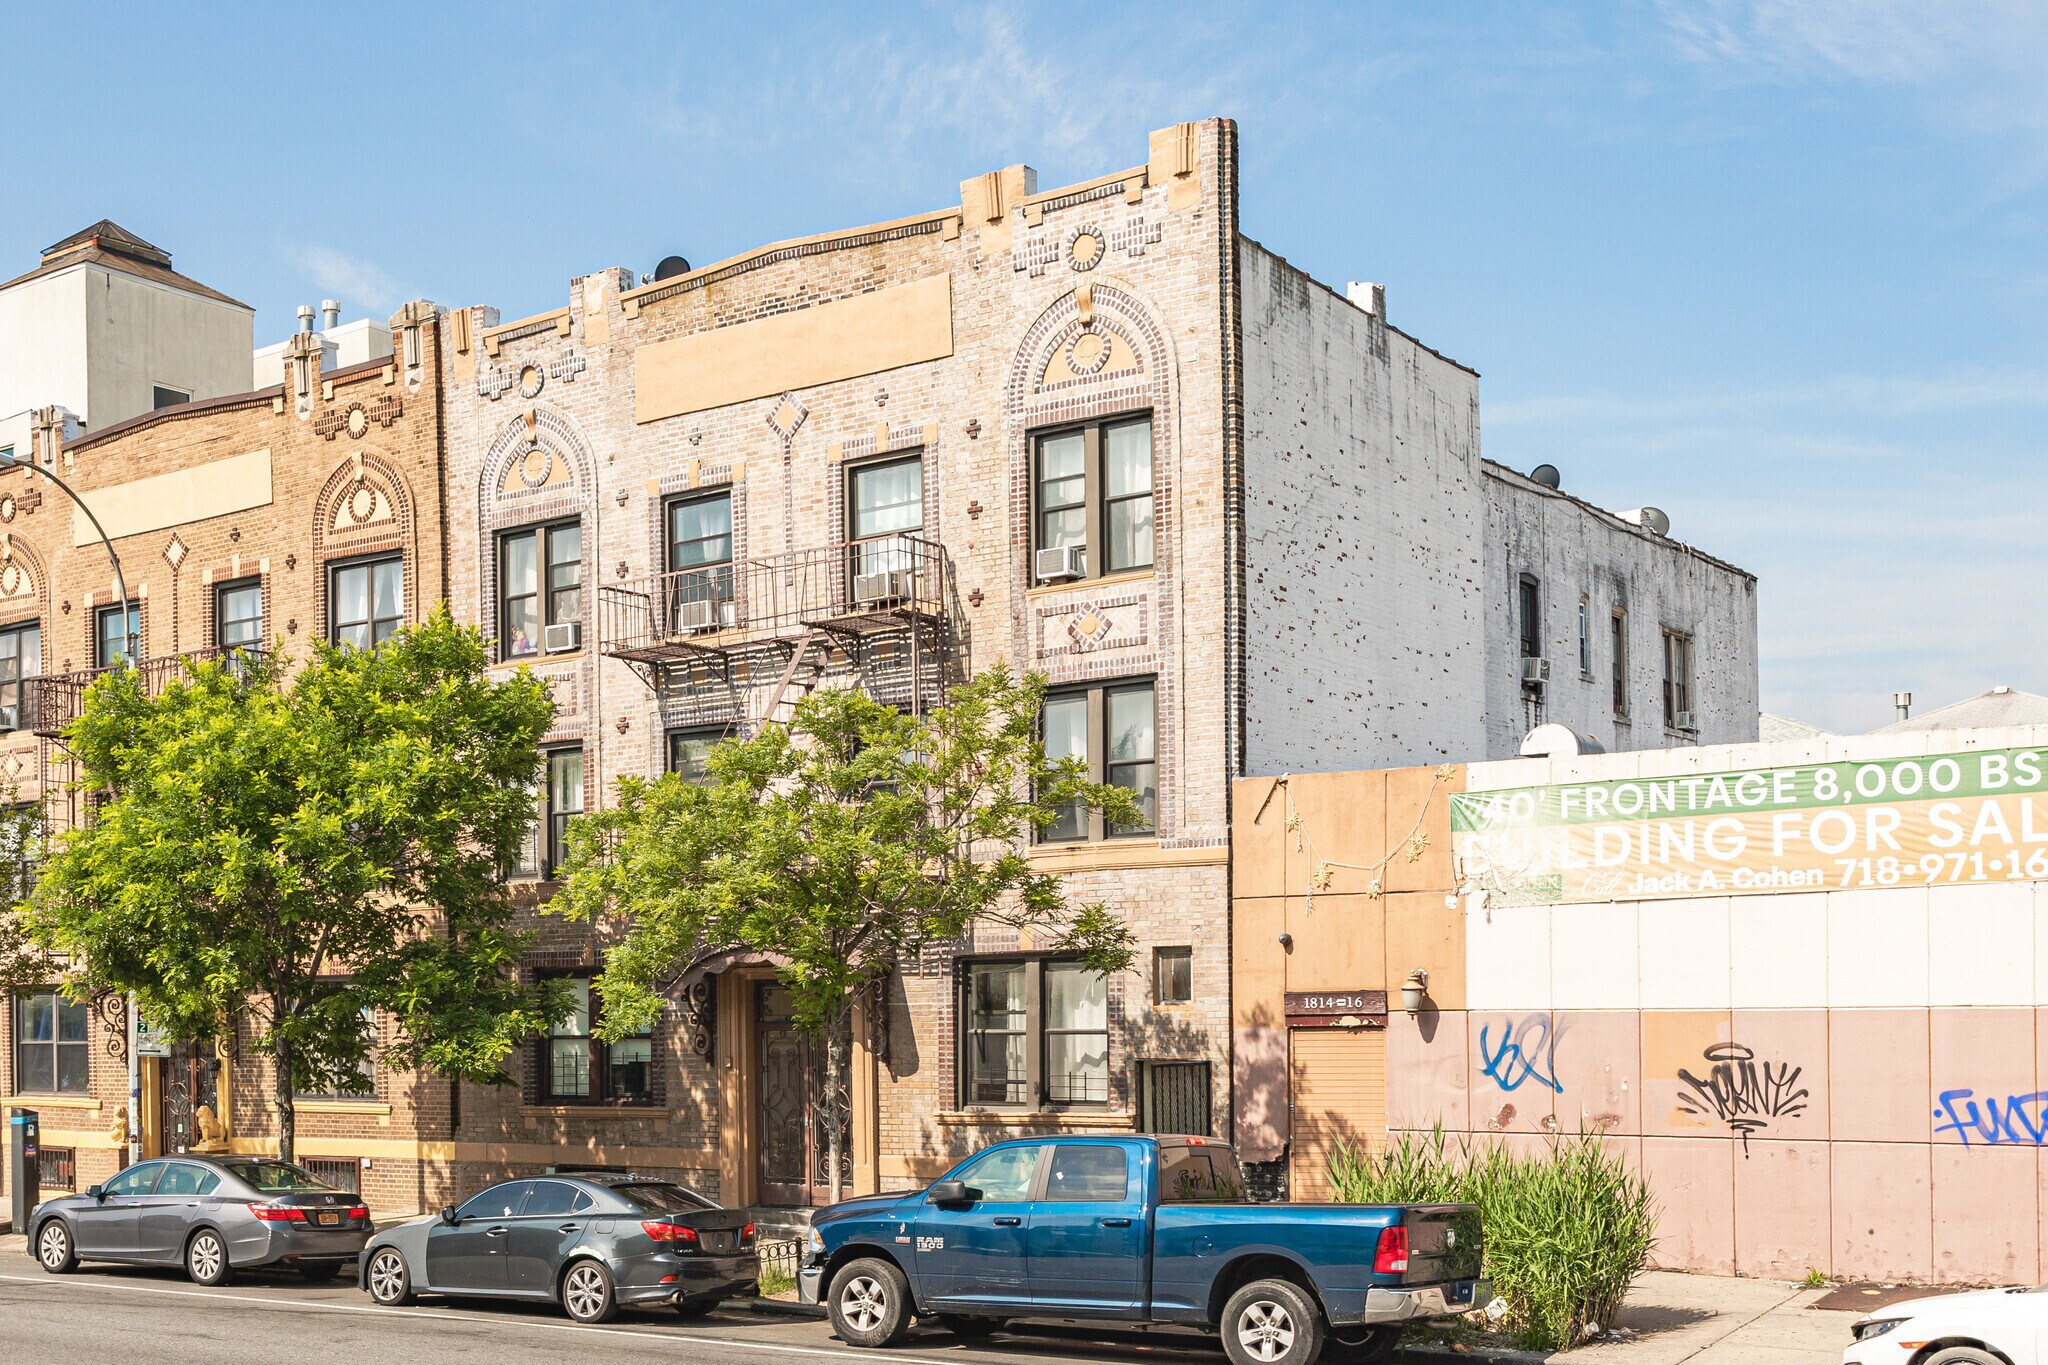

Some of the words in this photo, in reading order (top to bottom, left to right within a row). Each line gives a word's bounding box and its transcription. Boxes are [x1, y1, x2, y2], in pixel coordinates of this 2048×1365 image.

[1560, 771, 1797, 819] FRONTAGE
[1813, 758, 1961, 804] 8,000
[1772, 809, 1902, 857] FOR
[1627, 871, 1691, 894] Jack
[1699, 869, 1726, 892] A.
[1731, 865, 1824, 889] Cohen
